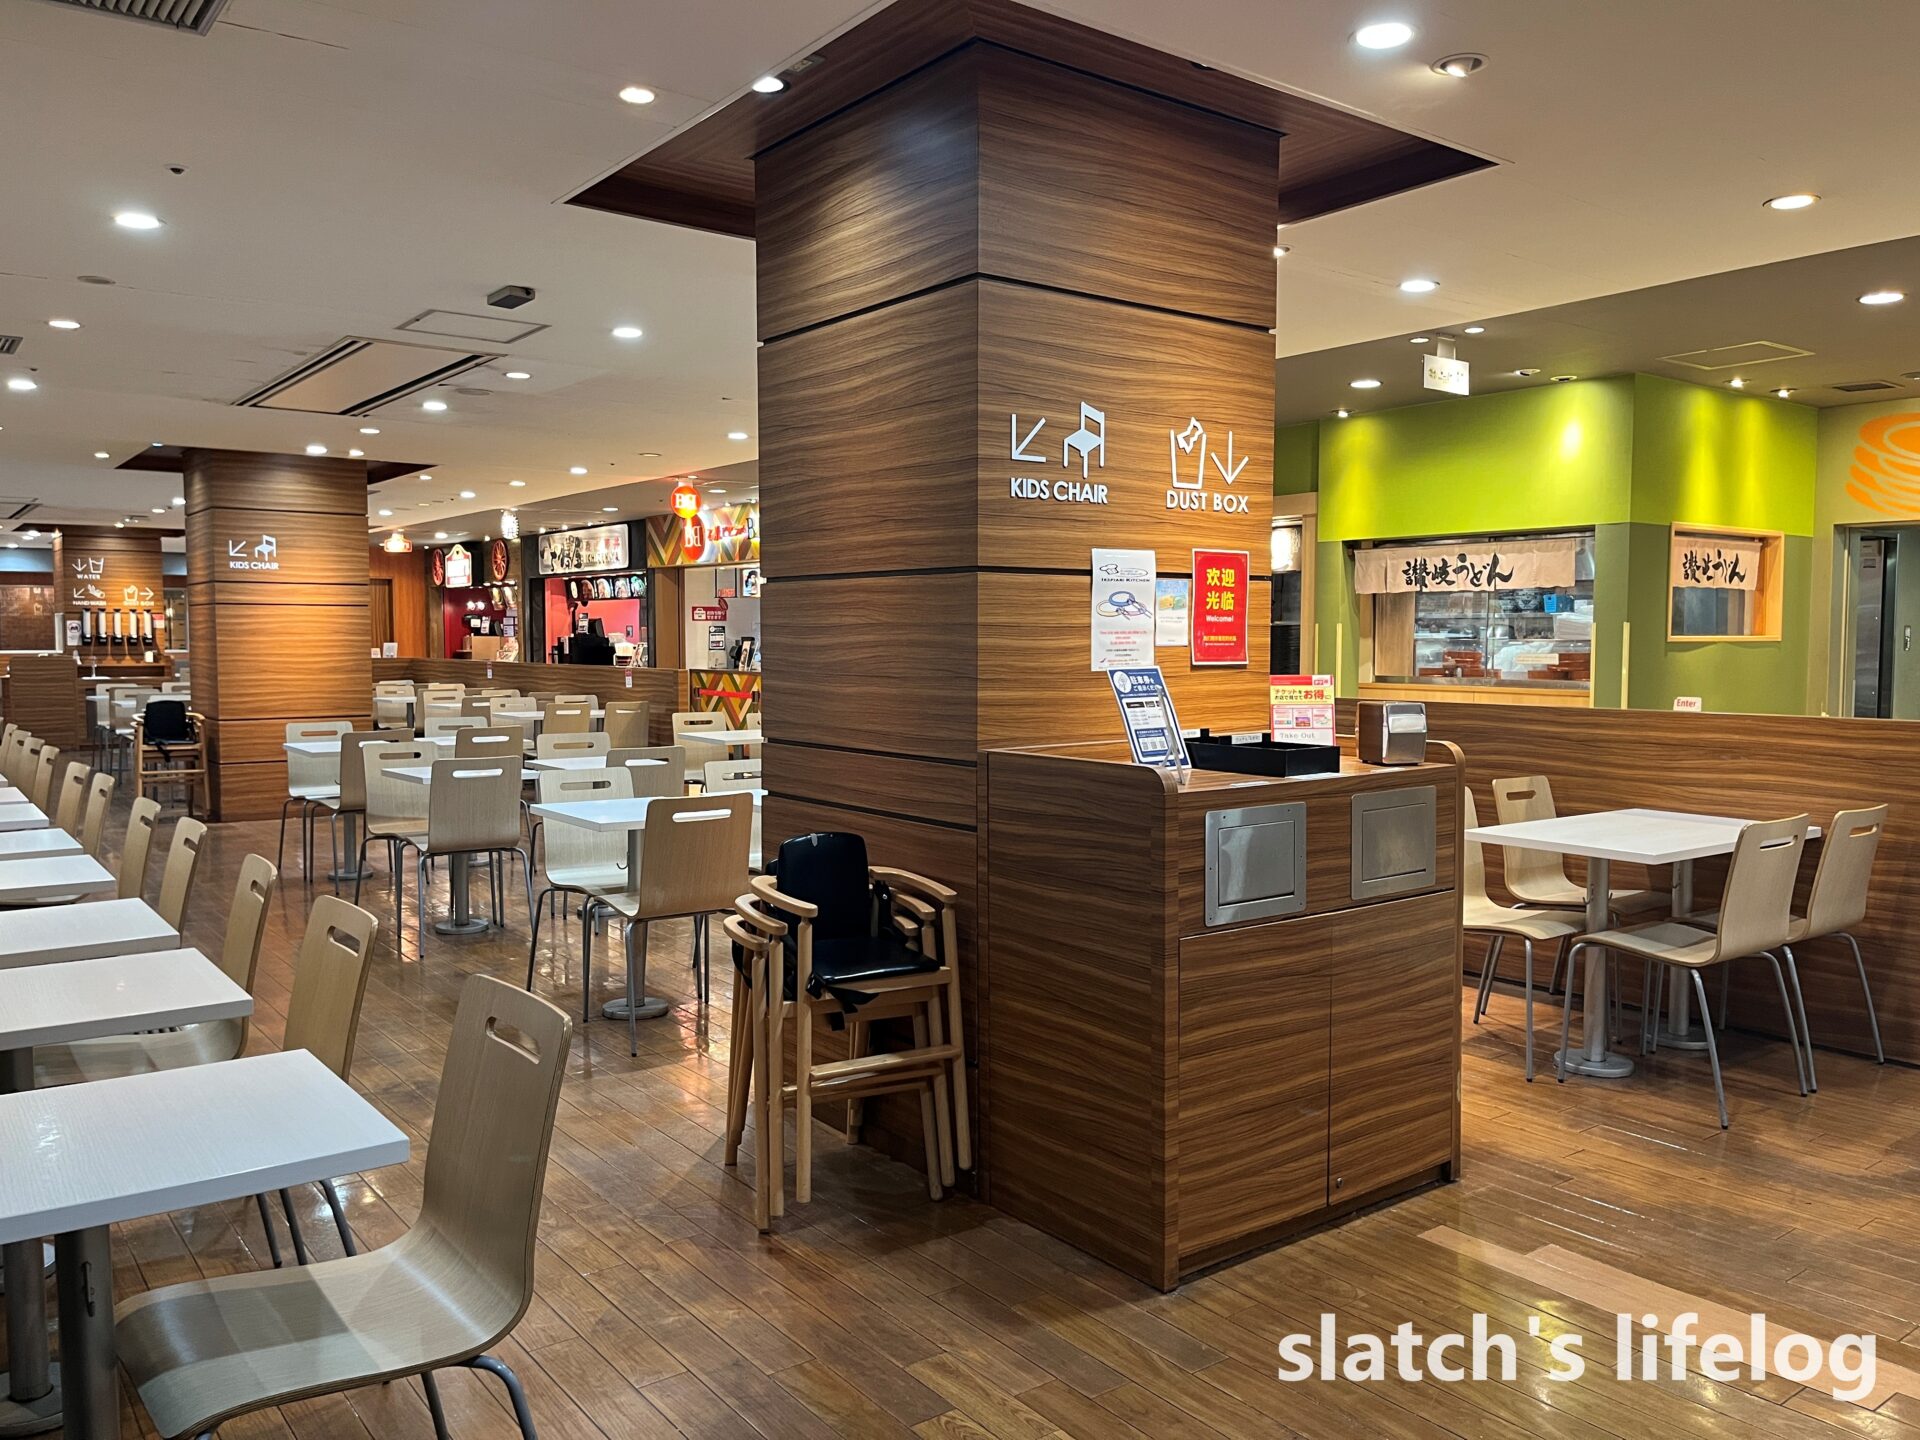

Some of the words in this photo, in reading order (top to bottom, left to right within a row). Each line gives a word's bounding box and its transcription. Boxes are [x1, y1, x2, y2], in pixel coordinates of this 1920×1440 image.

[1010, 478, 1050, 500] KIDS
[1053, 481, 1108, 504] CHAIR
[1166, 489, 1208, 511] DUST
[1213, 495, 1249, 514] BOX
[229, 560, 250, 569] KIDS
[250, 561, 280, 570] CHAIR
[1401, 552, 1515, 589] 讃岐うどん
[1206, 567, 1236, 588] 欢迎
[1206, 590, 1235, 611] 光临
[1676, 699, 1697, 708] Enter
